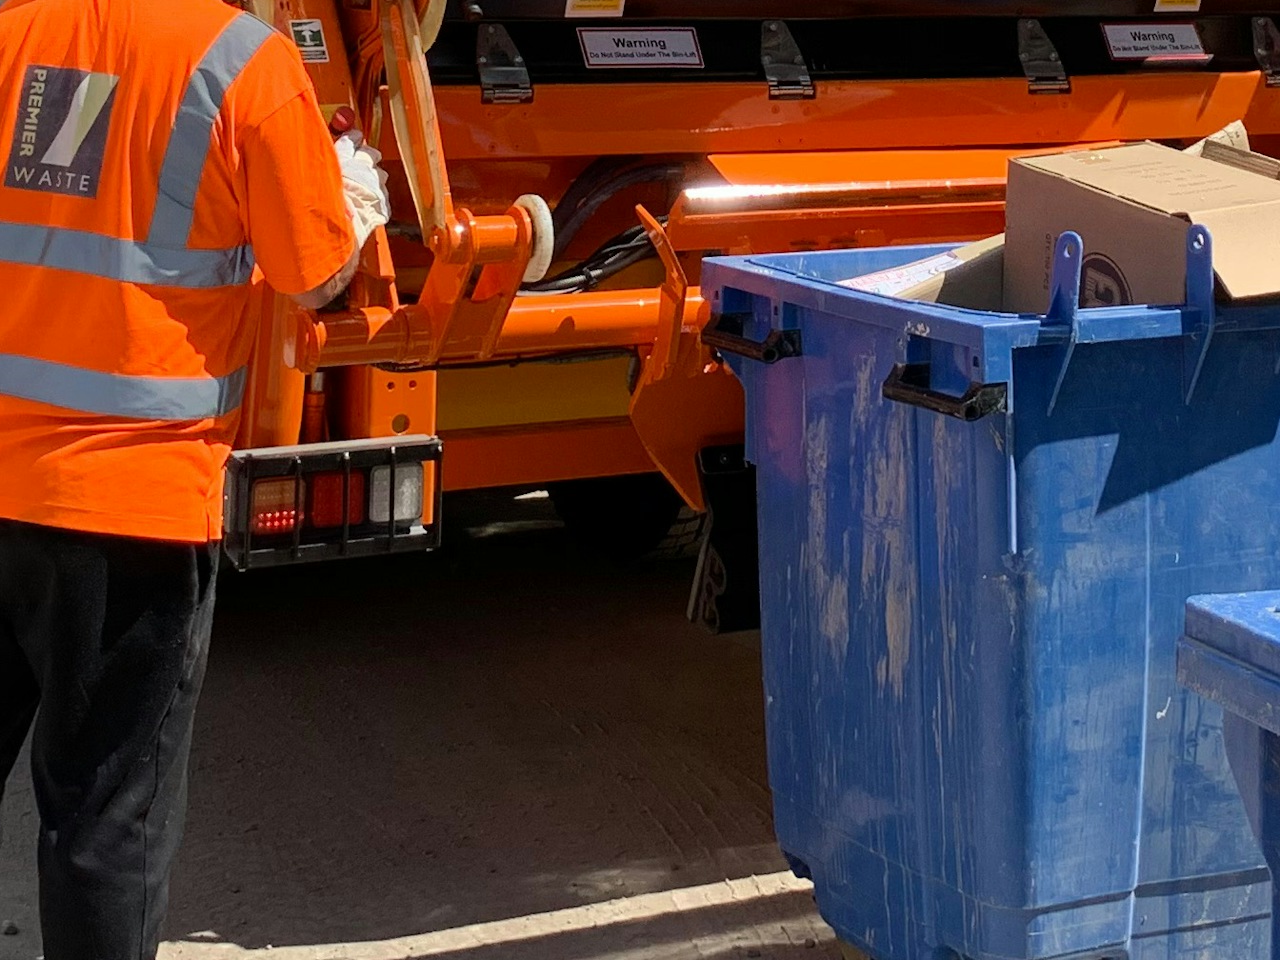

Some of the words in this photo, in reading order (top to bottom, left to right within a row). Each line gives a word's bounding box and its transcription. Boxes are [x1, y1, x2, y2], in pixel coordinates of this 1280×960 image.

[612, 37, 667, 50] Warning
[1130, 31, 1175, 43] Warning
[658, 51, 671, 59] The
[19, 68, 48, 157] PREMIER
[13, 166, 91, 192] WASTE
